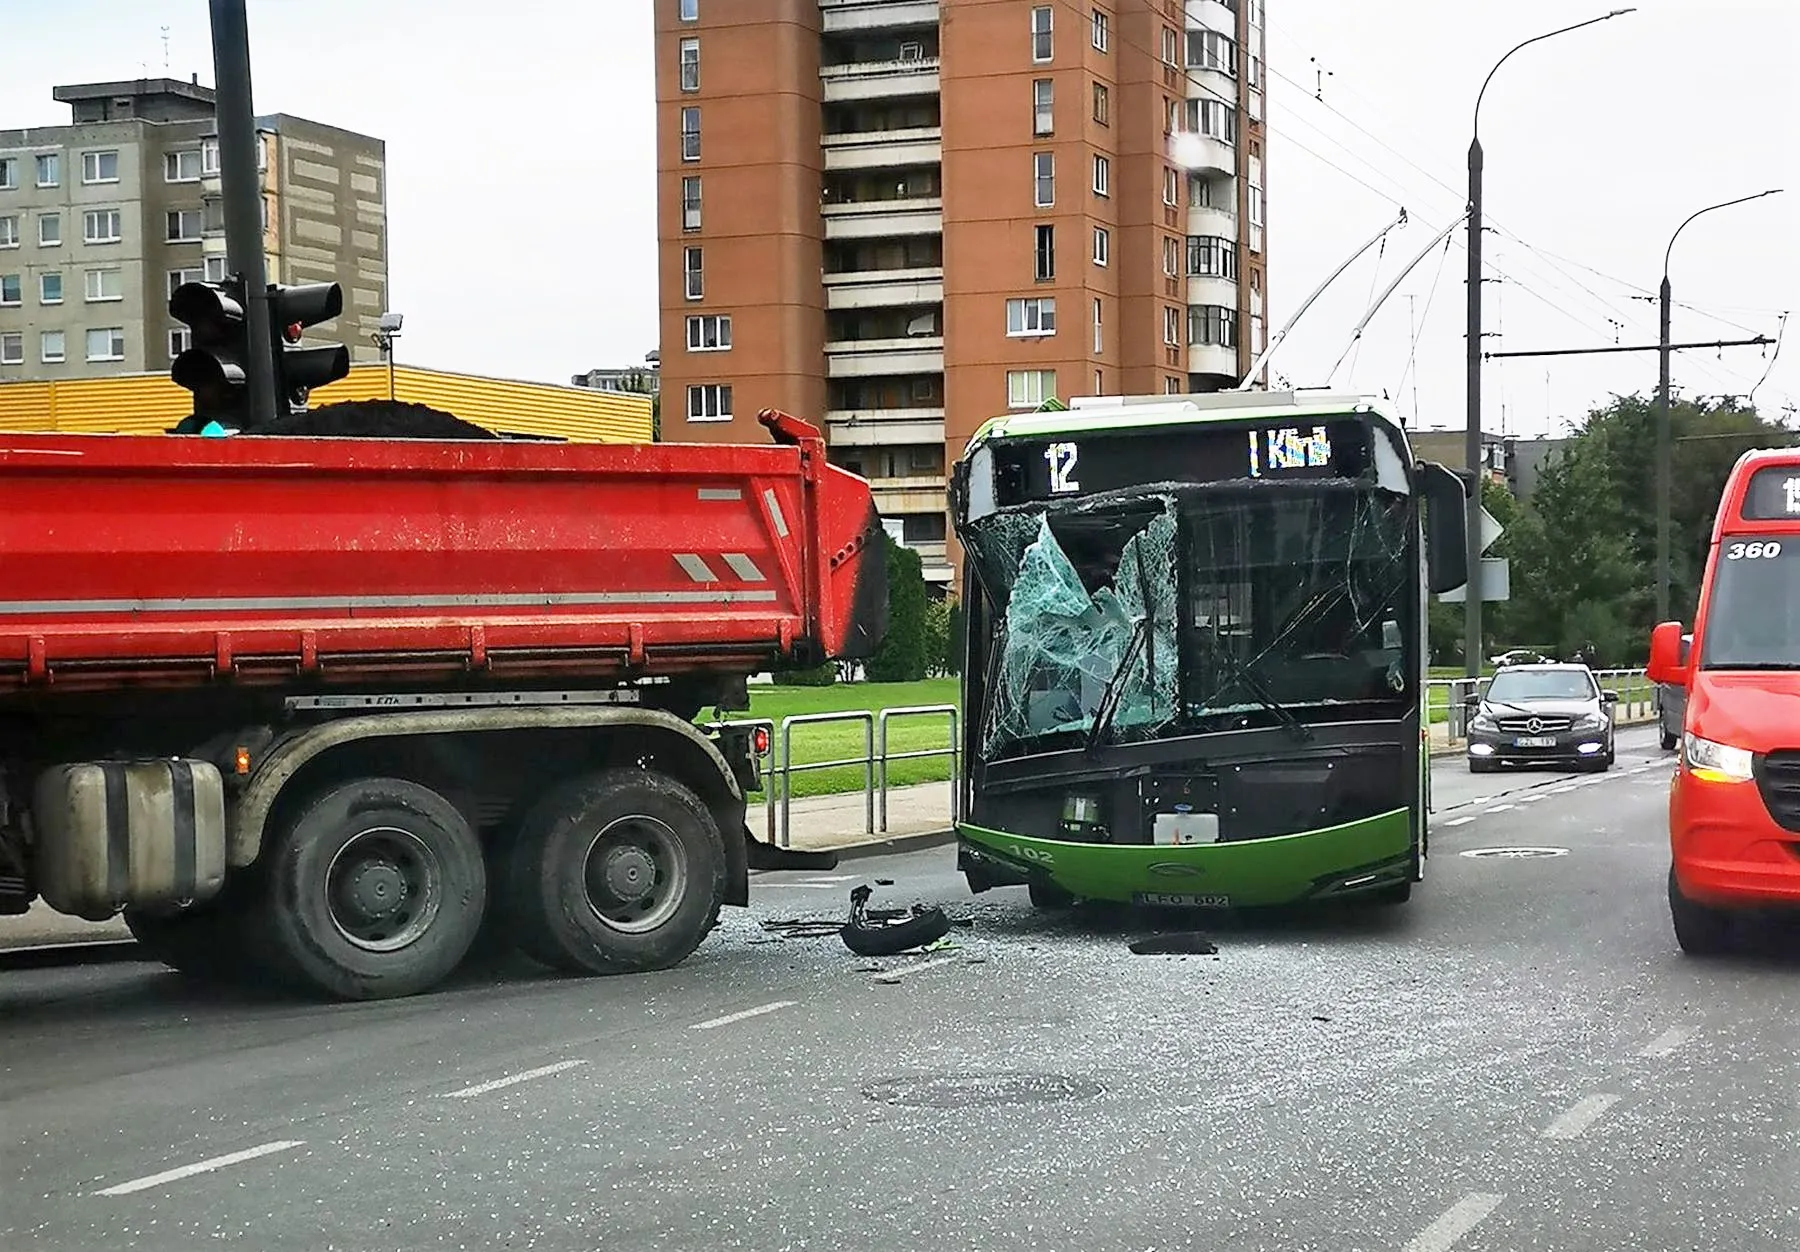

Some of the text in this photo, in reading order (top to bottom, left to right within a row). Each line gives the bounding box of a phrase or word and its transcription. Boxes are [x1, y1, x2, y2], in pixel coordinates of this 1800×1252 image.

[1044, 442, 1080, 493] 12
[1727, 541, 1781, 560] 360
[1008, 844, 1056, 864] 102
